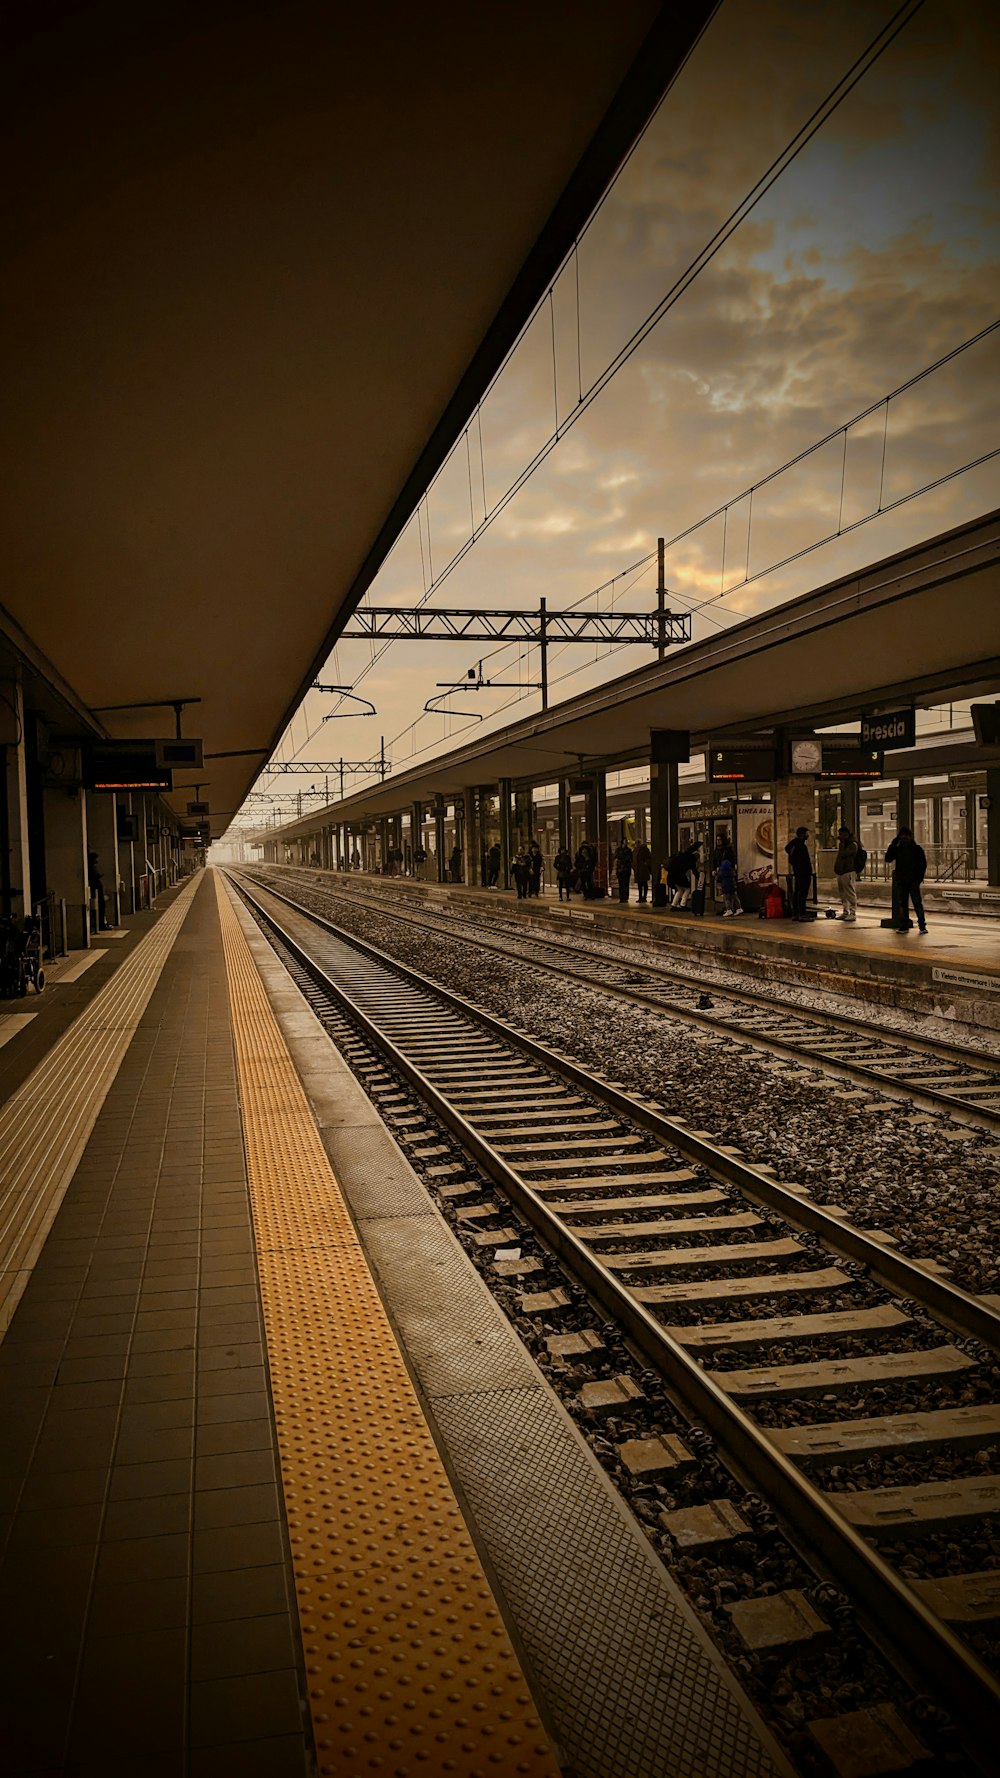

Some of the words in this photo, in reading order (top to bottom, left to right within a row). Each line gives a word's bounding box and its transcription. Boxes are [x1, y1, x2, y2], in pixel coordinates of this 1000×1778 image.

[862, 716, 905, 742] Brescia
[716, 752, 724, 761] 2
[871, 751, 878, 760] 3
